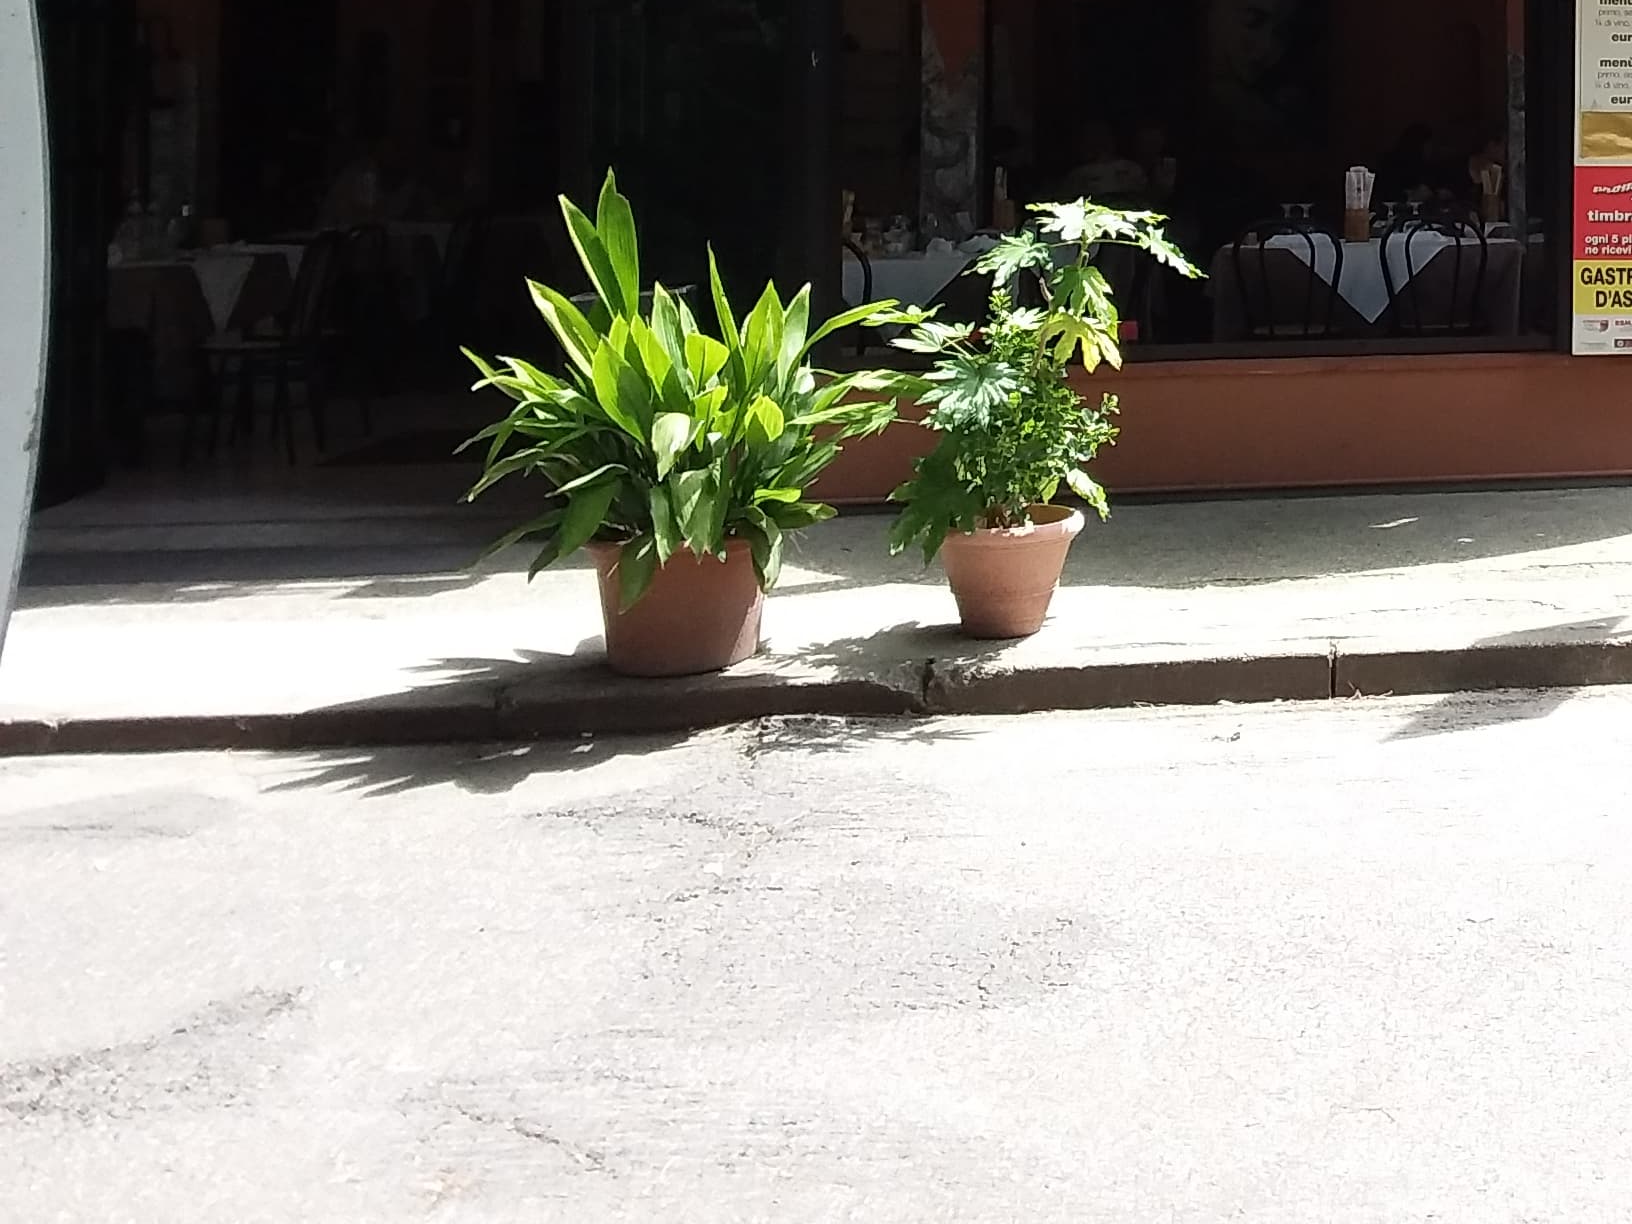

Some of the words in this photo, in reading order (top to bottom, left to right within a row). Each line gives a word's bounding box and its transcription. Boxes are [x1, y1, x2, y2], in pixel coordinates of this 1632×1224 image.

[1584, 234, 1609, 246] ogni
[1611, 234, 1619, 244] 5
[1584, 246, 1599, 255] ne
[1601, 245, 1632, 255] ricevi
